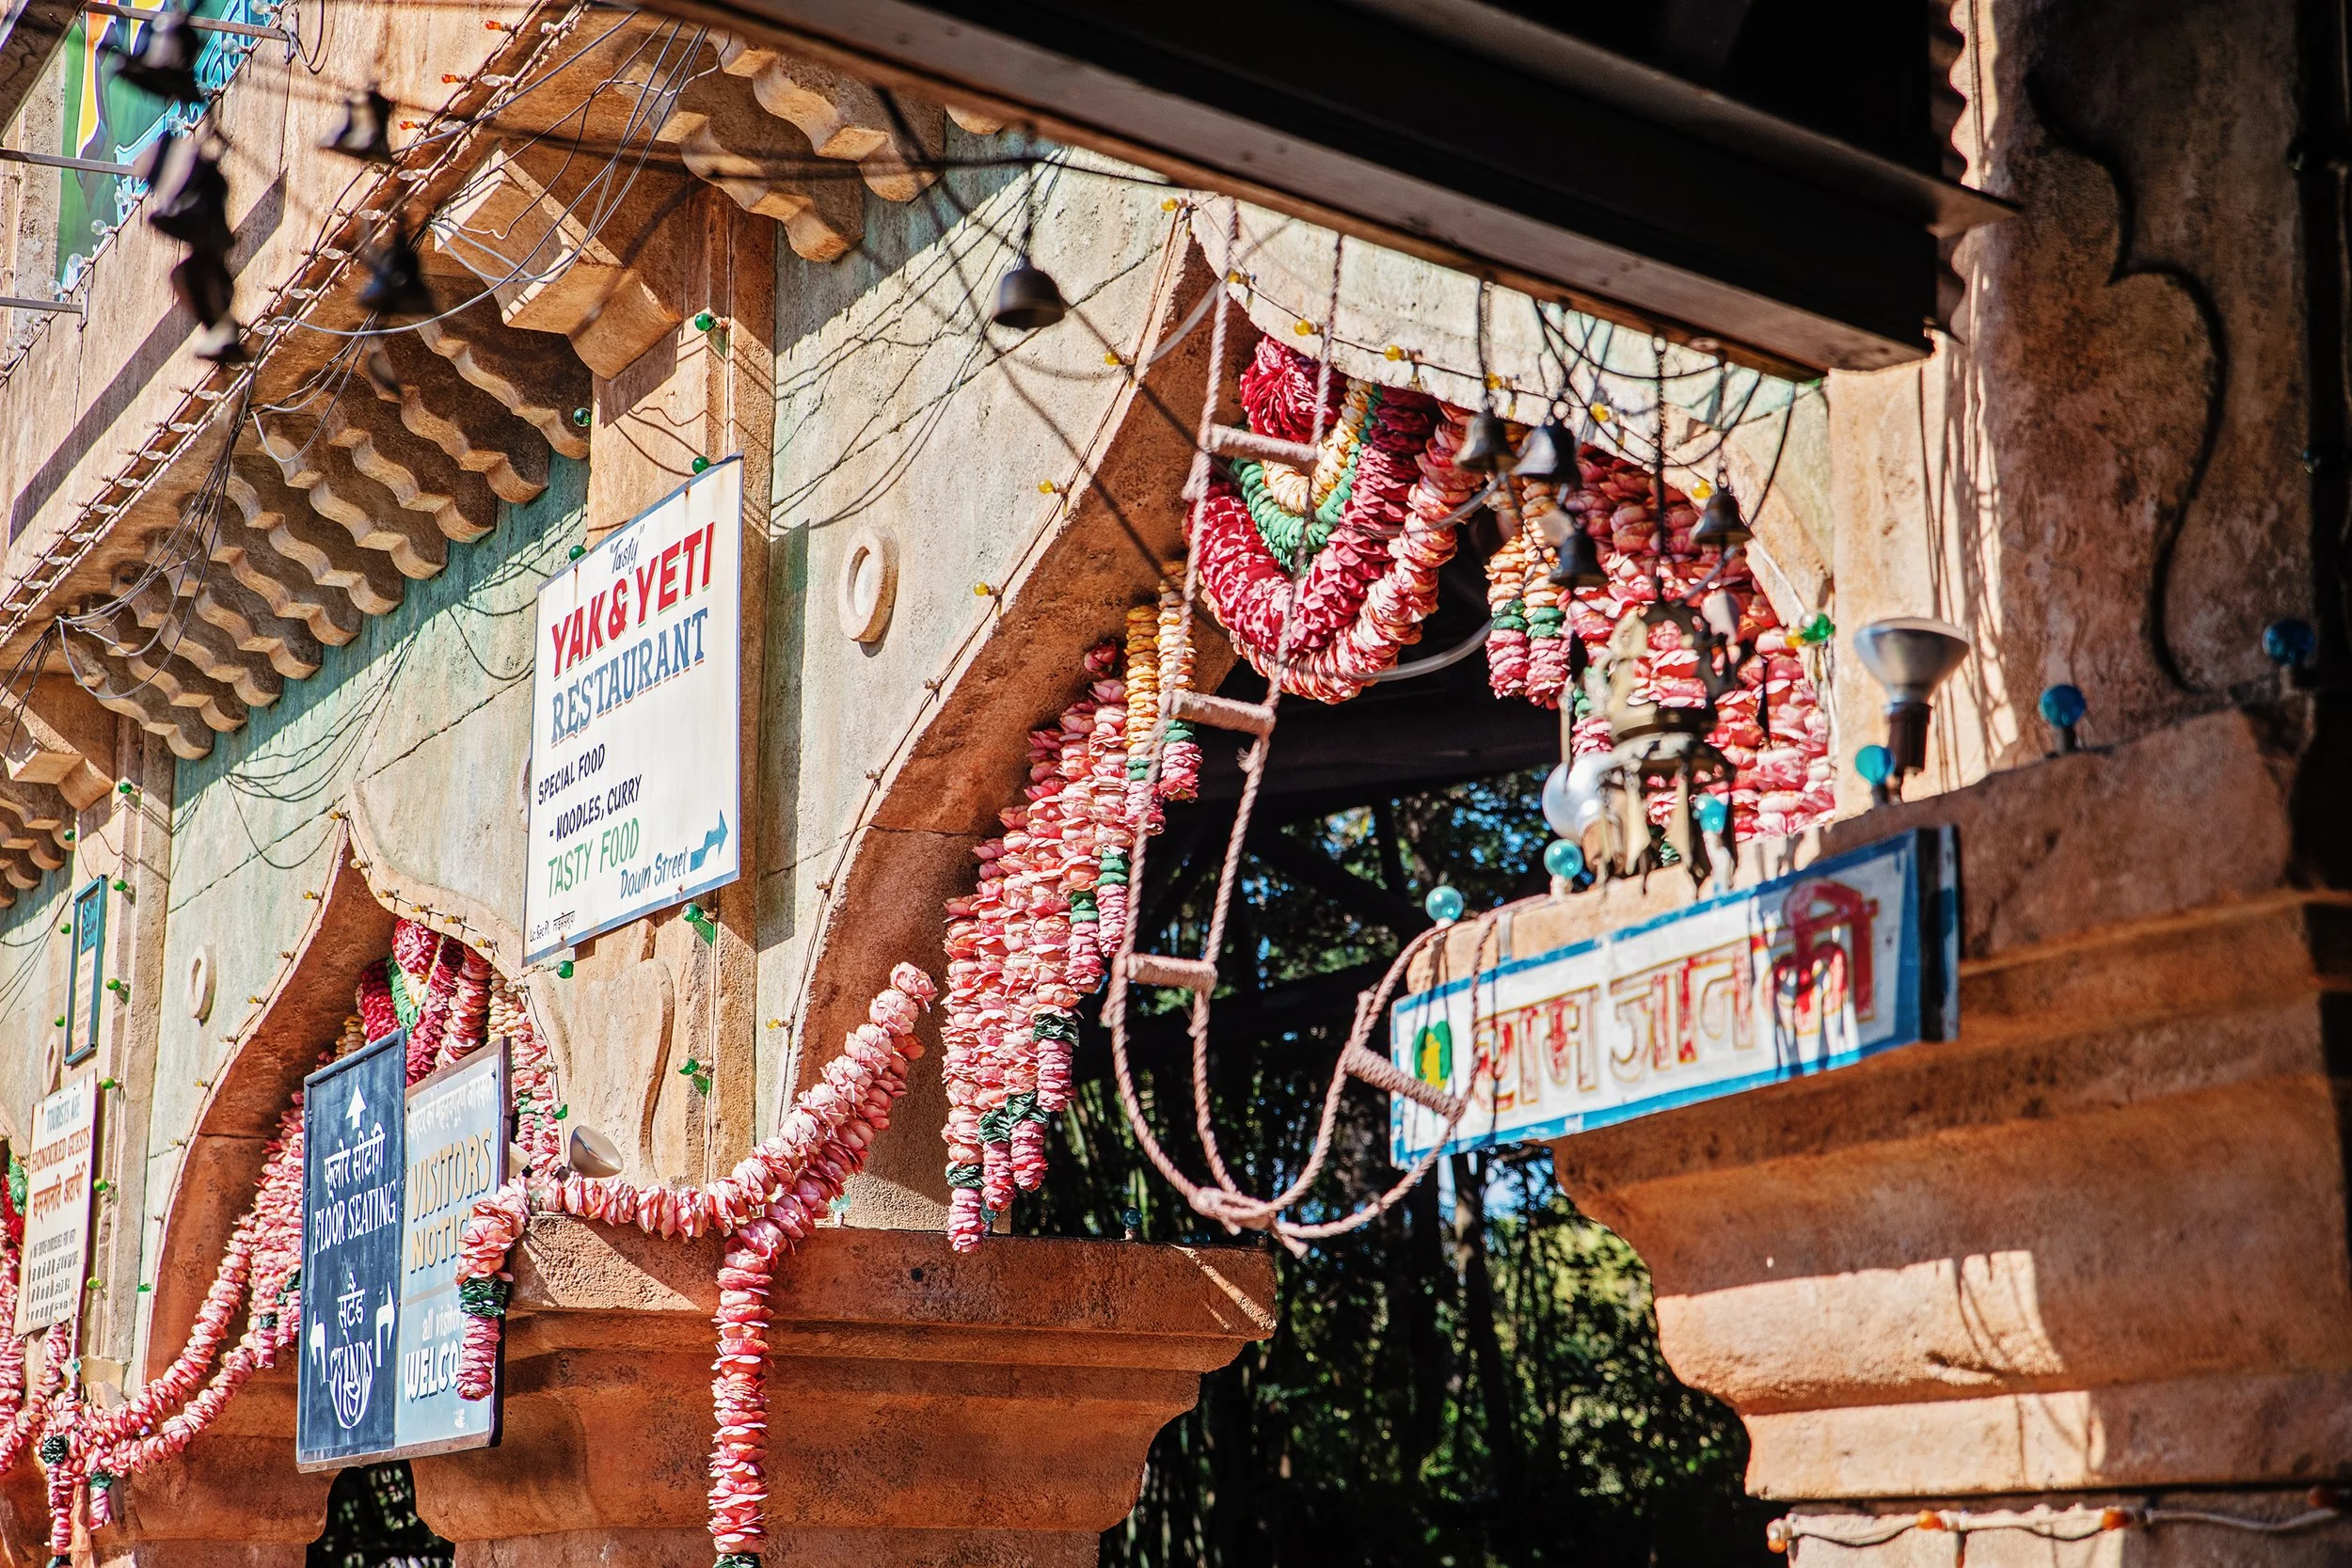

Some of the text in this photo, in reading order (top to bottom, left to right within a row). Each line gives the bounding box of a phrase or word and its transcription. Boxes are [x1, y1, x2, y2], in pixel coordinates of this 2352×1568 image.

[551, 521, 716, 679] YAK & YETI
[551, 608, 708, 746] RESTAURANT
[538, 743, 605, 806] SPECIAL FOOD
[556, 795, 605, 842] NOODLES,
[607, 774, 642, 816] CURRY
[548, 817, 639, 898] TASTY FOOD
[621, 847, 689, 899] Down Street
[47, 1094, 81, 1134] TOURISTS ARE
[31, 1126, 90, 1173] HONOURED GUESTS
[412, 1129, 492, 1223] VISITORS
[313, 1179, 397, 1255] FLOOR SEATING
[411, 1208, 470, 1274] NOTIC
[422, 1307, 434, 1342] all
[405, 1339, 461, 1402] WELCO
